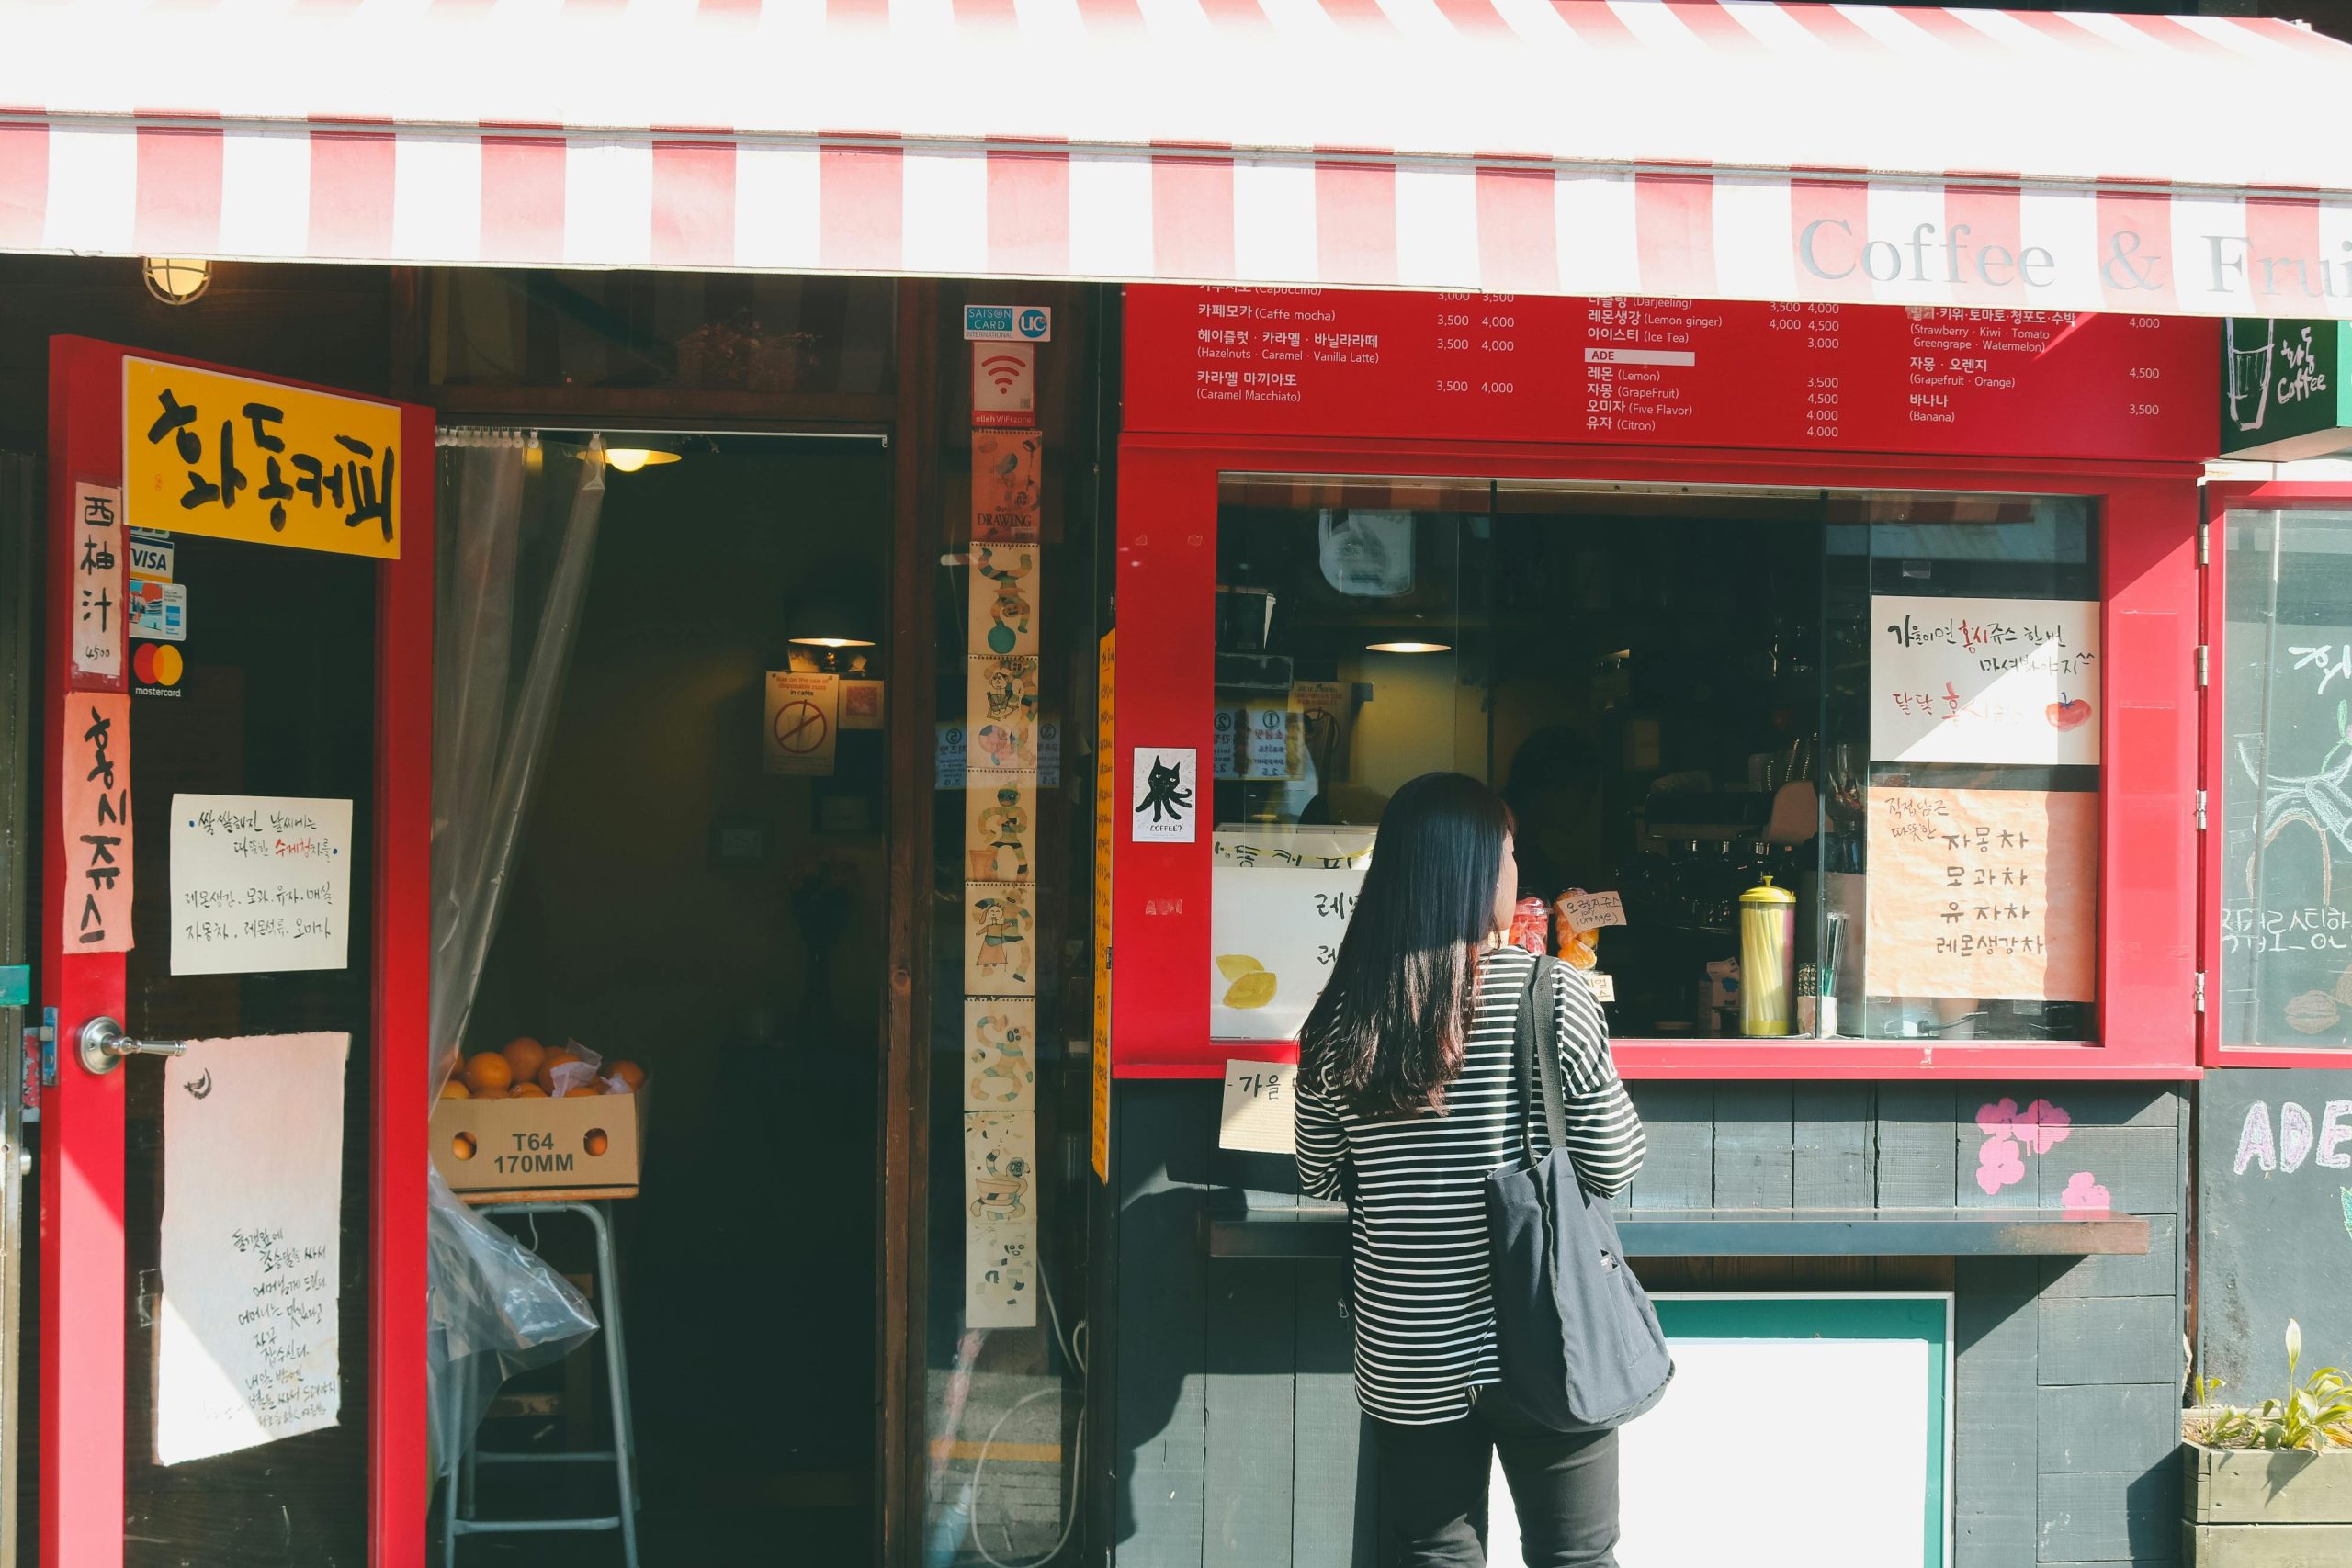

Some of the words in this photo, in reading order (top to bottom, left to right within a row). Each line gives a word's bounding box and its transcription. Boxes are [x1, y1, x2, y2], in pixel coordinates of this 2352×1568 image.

[1798, 218, 2057, 288] Coffee
[2100, 231, 2164, 292] &
[1438, 293, 1470, 301] 3,000
[1483, 294, 1514, 303] 3,500
[968, 309, 1011, 319] SAISON
[1198, 304, 1252, 319] 카페모카
[1255, 308, 1291, 320] (Caffe
[1295, 310, 1336, 321] mocha)
[1770, 302, 1800, 313] 3,500
[1808, 303, 1839, 314] 4,000
[974, 320, 1005, 330] CARD
[1437, 314, 1469, 326] 3,500
[1481, 316, 1514, 328] 4,000
[1588, 310, 1641, 326] 레몬생강
[1645, 313, 1682, 325] (Lemon
[1686, 316, 1723, 328] ginger)
[1769, 319, 1801, 331] 4,000
[1808, 321, 1839, 332] 4,500
[2129, 318, 2160, 329] 4,000
[1587, 327, 1639, 342] 아이스티
[1644, 332, 1662, 344] (Ice
[1667, 333, 1689, 344] Tea)
[1910, 323, 1969, 337] (Strawberry
[1980, 327, 2001, 337] Kiwi
[2012, 328, 2050, 339] Tomato
[1197, 329, 1250, 345] 헤이즐럿
[1262, 332, 1300, 347] 카라멜
[1314, 333, 1378, 348] 바닐라라떼
[1437, 338, 1469, 350] 3,500
[1481, 340, 1514, 352] 4,000
[1808, 338, 1839, 349] 3,000
[1913, 338, 1972, 351] Greengrape
[1983, 340, 2046, 353] Watermelon)
[1197, 346, 1251, 359] (Hazelnuts
[1261, 349, 1303, 361] Caramel
[1314, 351, 1347, 362] Vanilla
[1350, 352, 1379, 364] Latte)
[1591, 351, 1614, 360] ADE
[1910, 356, 1935, 372] 자몽
[1950, 358, 1987, 374] 오렌지
[1197, 370, 1238, 387] 카라멜
[1243, 371, 1297, 386] 마끼아또
[1587, 367, 1613, 381] 레몬
[1618, 369, 1660, 381] (Lemon)
[2129, 367, 2159, 378] 4,500
[1436, 380, 1468, 392] 3,500
[1480, 382, 1514, 394] 4,000
[1807, 377, 1838, 389] 3,500
[1910, 374, 1964, 386] (Grapefruit
[1975, 377, 2016, 389] Orange)
[2278, 367, 2326, 404] Coffee
[1196, 388, 1241, 400] (Caramel
[1246, 389, 1301, 402] Macchiato)
[1587, 383, 1613, 399] 자몽
[1618, 386, 1679, 400] (GrapeFruit)
[1807, 393, 1838, 404] 4,500
[1587, 400, 1625, 413] 오미자
[1629, 403, 1654, 414] (Five
[1657, 405, 1692, 416] Flavor)
[1910, 394, 1949, 408] 바나나
[1806, 410, 1838, 422] 4,000
[2129, 404, 2159, 415] 3,500
[1587, 416, 1612, 430] 유자
[1617, 419, 1656, 431] (Citron)
[1909, 411, 1955, 423] (Banana)
[1806, 426, 1838, 437] 4,000
[977, 513, 1032, 527] DRAWING
[131, 548, 167, 570] VISA
[135, 687, 182, 697] mastercard
[1941, 827, 2030, 853] 자몽차
[1946, 866, 2028, 887] 모과차
[1940, 901, 2030, 924] 유자차
[1936, 934, 2044, 956] 레몬생강차
[512, 1132, 554, 1152] T64
[2233, 1100, 2352, 1176] ADE
[494, 1153, 574, 1174] 170MM
